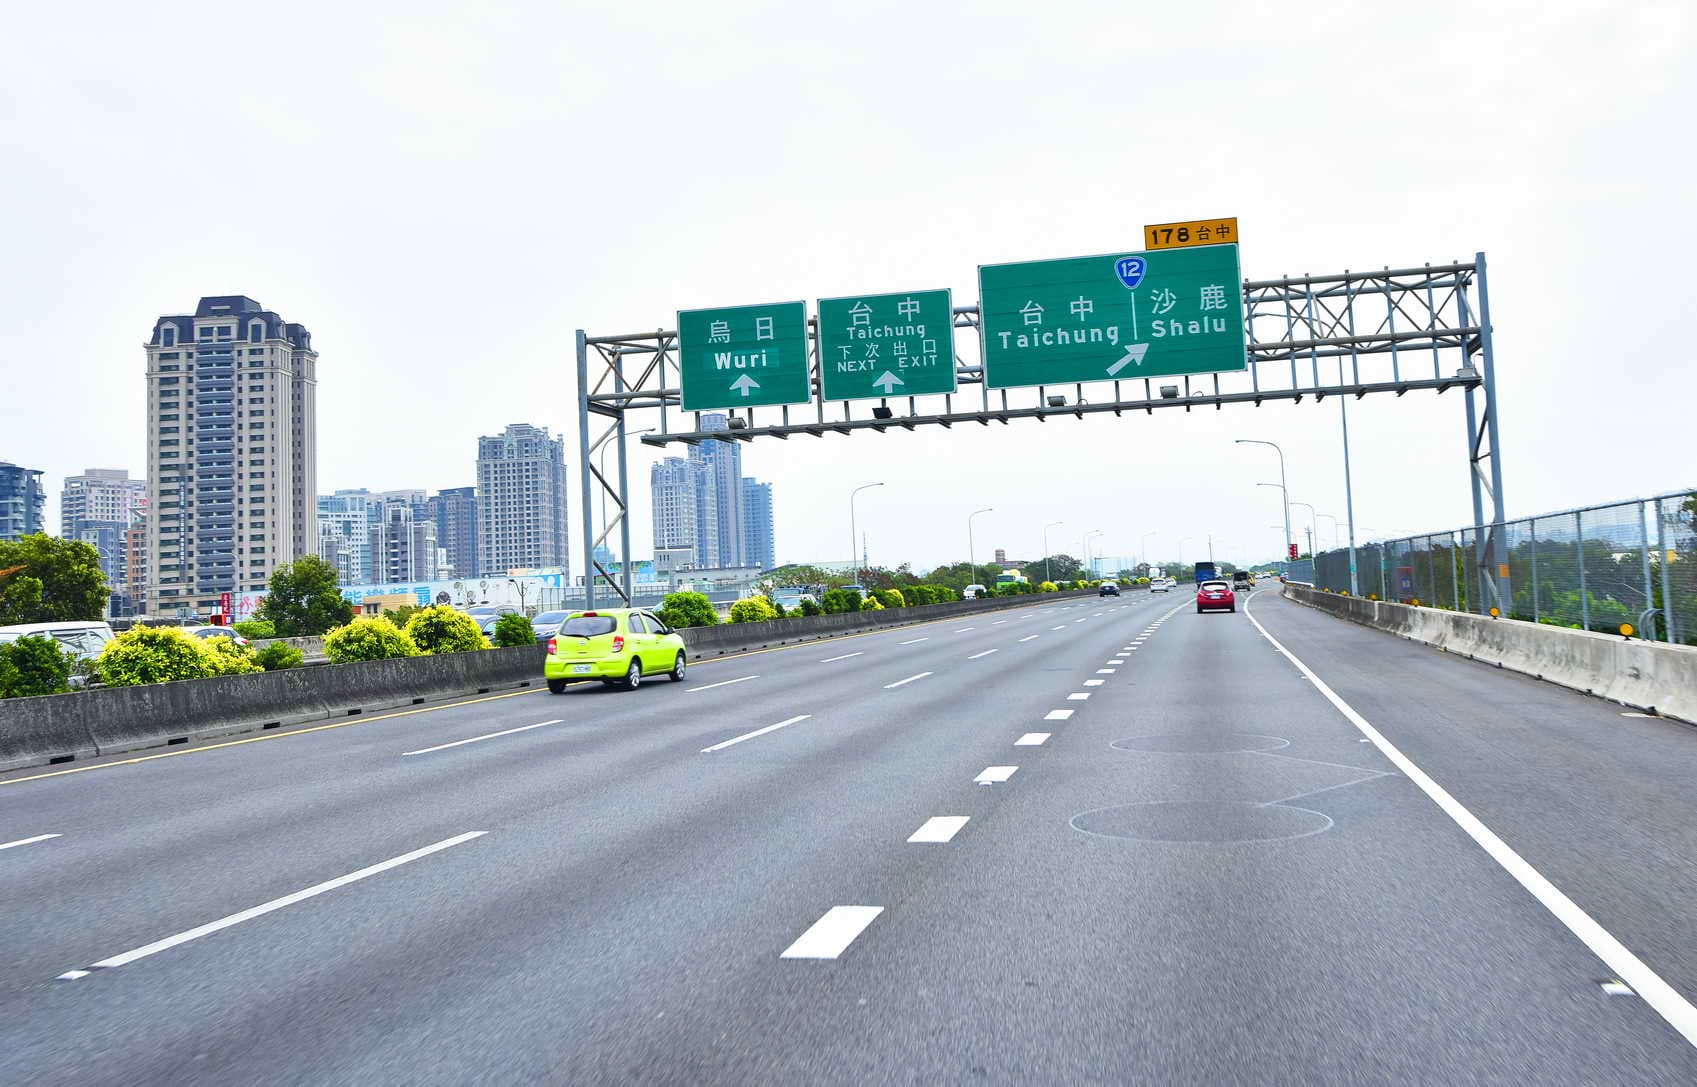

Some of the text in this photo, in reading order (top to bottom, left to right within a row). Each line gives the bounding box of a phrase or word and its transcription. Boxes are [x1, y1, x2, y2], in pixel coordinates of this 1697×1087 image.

[1151, 223, 1231, 245] 178 台中
[1121, 261, 1140, 278] 12
[1019, 295, 1094, 326] 台中
[1150, 284, 1228, 315] 沙鹿
[848, 296, 921, 327] 台中
[846, 323, 927, 340] Taichung
[998, 325, 1119, 349] Taichung
[1151, 316, 1227, 337] Shalu
[714, 349, 768, 370] Wuri
[837, 339, 937, 361] 下次出口
[837, 354, 938, 373] NEXT EXIT
